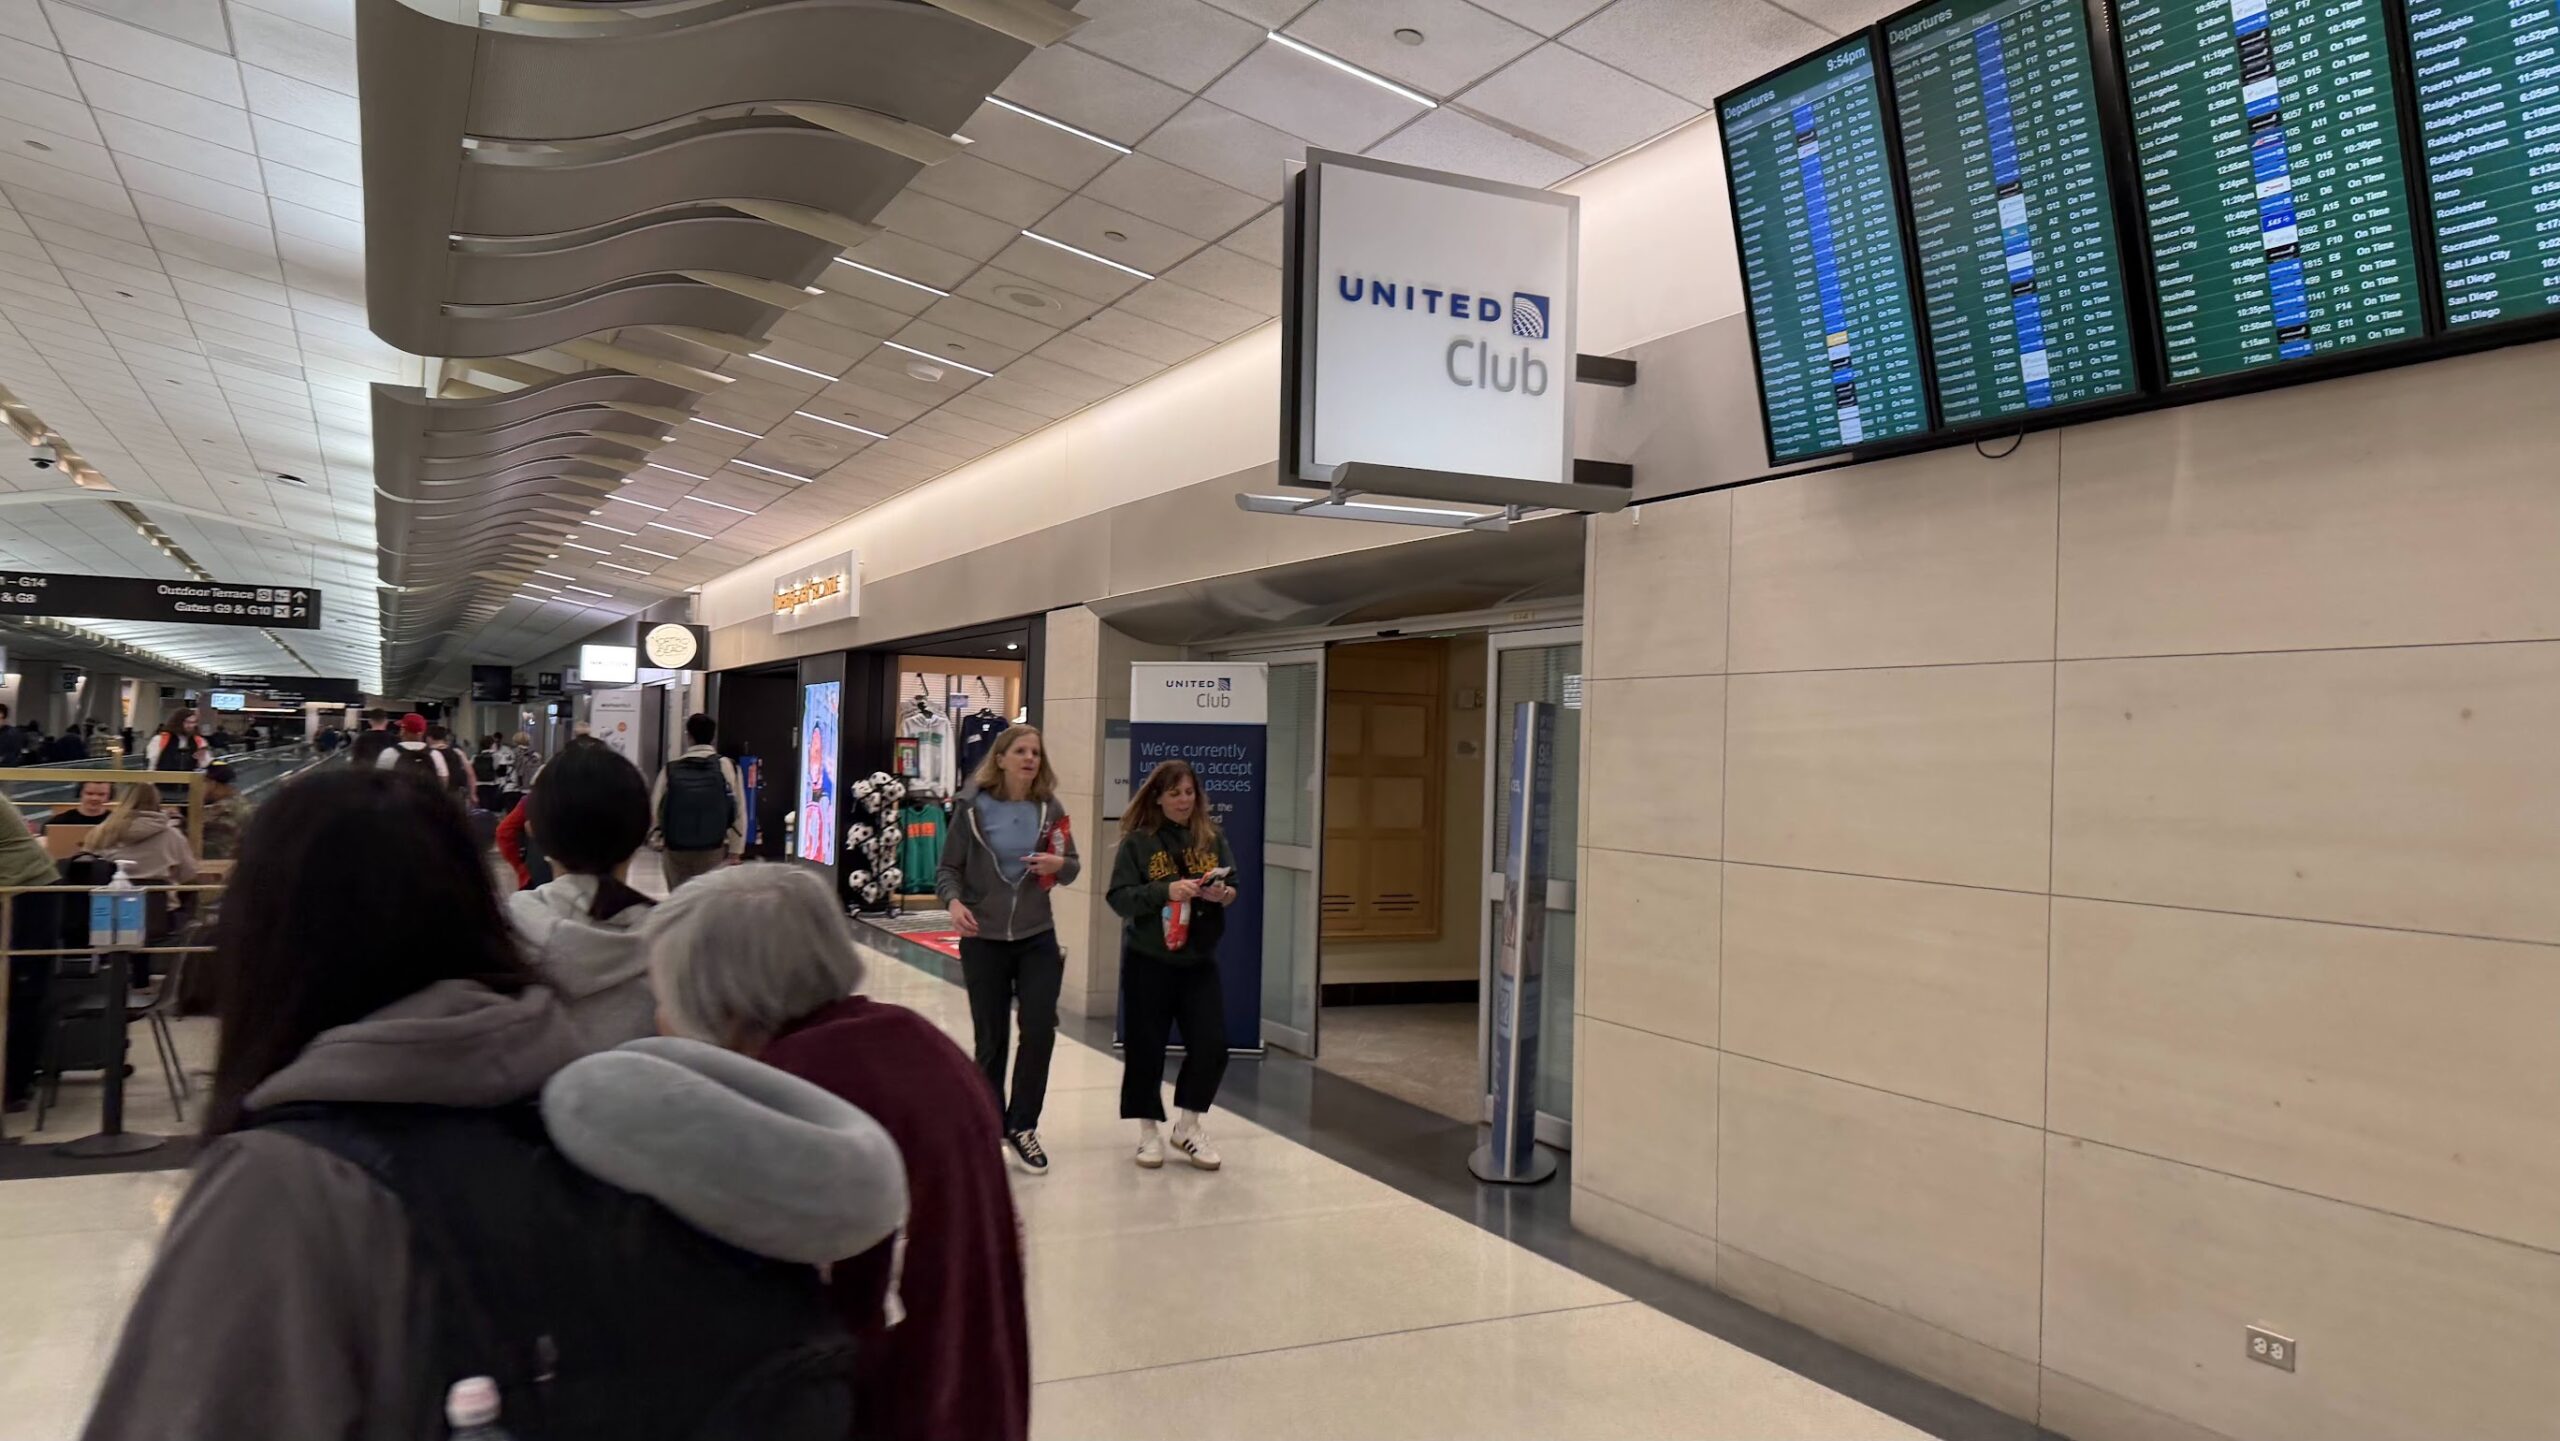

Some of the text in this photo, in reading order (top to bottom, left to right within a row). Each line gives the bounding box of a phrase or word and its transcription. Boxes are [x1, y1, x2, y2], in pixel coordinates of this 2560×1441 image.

[2122, 7, 2160, 26] LaGuardia
[2411, 7, 2442, 24] Pasco
[1889, 8, 1953, 44] Departures
[2124, 23, 2162, 42] Las Vegas
[2413, 15, 2474, 41] Philadelphia
[2025, 42, 2075, 65] F17 On Time
[2126, 39, 2164, 58] Las Vegas
[2131, 74, 2159, 88] London
[2159, 60, 2196, 78] Heathrow
[2297, 14, 2315, 27] A12
[2325, 7, 2339, 17] On
[2340, 0, 2363, 12] Time
[2415, 36, 2467, 59] Pittsburgh
[1827, 47, 1865, 72] 9:54pm
[2133, 16, 2366, 104] Los Angeles D7 10:15pm
[2418, 56, 2460, 77] Portland
[2135, 110, 2150, 119] Los
[2150, 99, 2181, 114] Angeles
[2302, 48, 2319, 61] E13
[2329, 42, 2344, 51] On
[2344, 34, 2367, 46] Time
[2420, 79, 2453, 95] Puerto
[2453, 67, 2492, 84] Vallarta
[2137, 51, 2370, 135] Los Angeles D15 On Time
[2308, 99, 2325, 112] F15
[2336, 94, 2350, 103] On
[2351, 86, 2374, 98] Time
[2422, 83, 2502, 112] Raleigh-Durham
[1724, 89, 1775, 119] Departures
[2139, 84, 2319, 150] Los Cabos E5
[2311, 116, 2327, 128] A11
[2338, 111, 2353, 120] On
[2353, 103, 2376, 115] Time
[2424, 101, 2504, 130] Raleigh-Durham
[2313, 134, 2326, 145] G2
[2427, 120, 2506, 148] Raleigh-Durham
[2315, 150, 2333, 162] D15
[2343, 138, 2382, 154] 10:30pm
[2429, 138, 2509, 166] Raleigh-Durham
[2063, 167, 2074, 175] On
[2074, 162, 2091, 171] Time
[2345, 162, 2360, 171] On
[2360, 155, 2383, 167] Time
[2431, 166, 2473, 183] Redding
[2434, 188, 2461, 201] Reno
[2081, 207, 2098, 216] Time
[2153, 230, 2179, 242] Mexico
[2179, 225, 2195, 234] City
[2347, 179, 2362, 188] On
[2362, 172, 2385, 184] Time
[2352, 213, 2366, 222] On
[2367, 207, 2390, 218] Time
[2436, 200, 2487, 218] Rochester
[2155, 245, 2182, 257] Mexico
[2181, 240, 2197, 250] City
[2322, 200, 2339, 212] A15
[2349, 196, 2364, 205] On
[2364, 190, 2387, 201] Time
[2354, 230, 2368, 239] On
[2369, 224, 2392, 235] Time
[2438, 216, 2498, 236] Sacramento
[2441, 234, 2500, 253] Sacramento
[2358, 264, 2373, 272] On
[2373, 258, 2396, 269] Time
[2443, 250, 2510, 271] Salt Lake City
[2333, 275, 2399, 295] F15 On Time
[2445, 272, 2496, 288] San Diego
[1339, 275, 1502, 322] UNITED
[2060, 295, 2110, 312] F11 On Time
[2335, 301, 2352, 311] F14
[2448, 290, 2498, 306] San Diego
[2062, 317, 2075, 326] F17
[2094, 310, 2112, 318] Time
[2337, 309, 2403, 328] E11 On Time
[2450, 307, 2500, 323] San Diego
[2367, 331, 2382, 339] On
[2382, 326, 2405, 336] Time
[1446, 339, 1548, 397] Club
[19, 577, 47, 588] G14
[157, 584, 254, 599] Outdoor Terrace
[2, 593, 14, 602] &
[174, 601, 271, 615] Gates G9 & G10
[1166, 680, 1215, 688] UNITED
[1197, 693, 1230, 708] Club
[1140, 742, 1247, 760] We're currently
[1208, 762, 1253, 776] accept
[1205, 780, 1251, 792] passes
[1217, 803, 1233, 812] the
